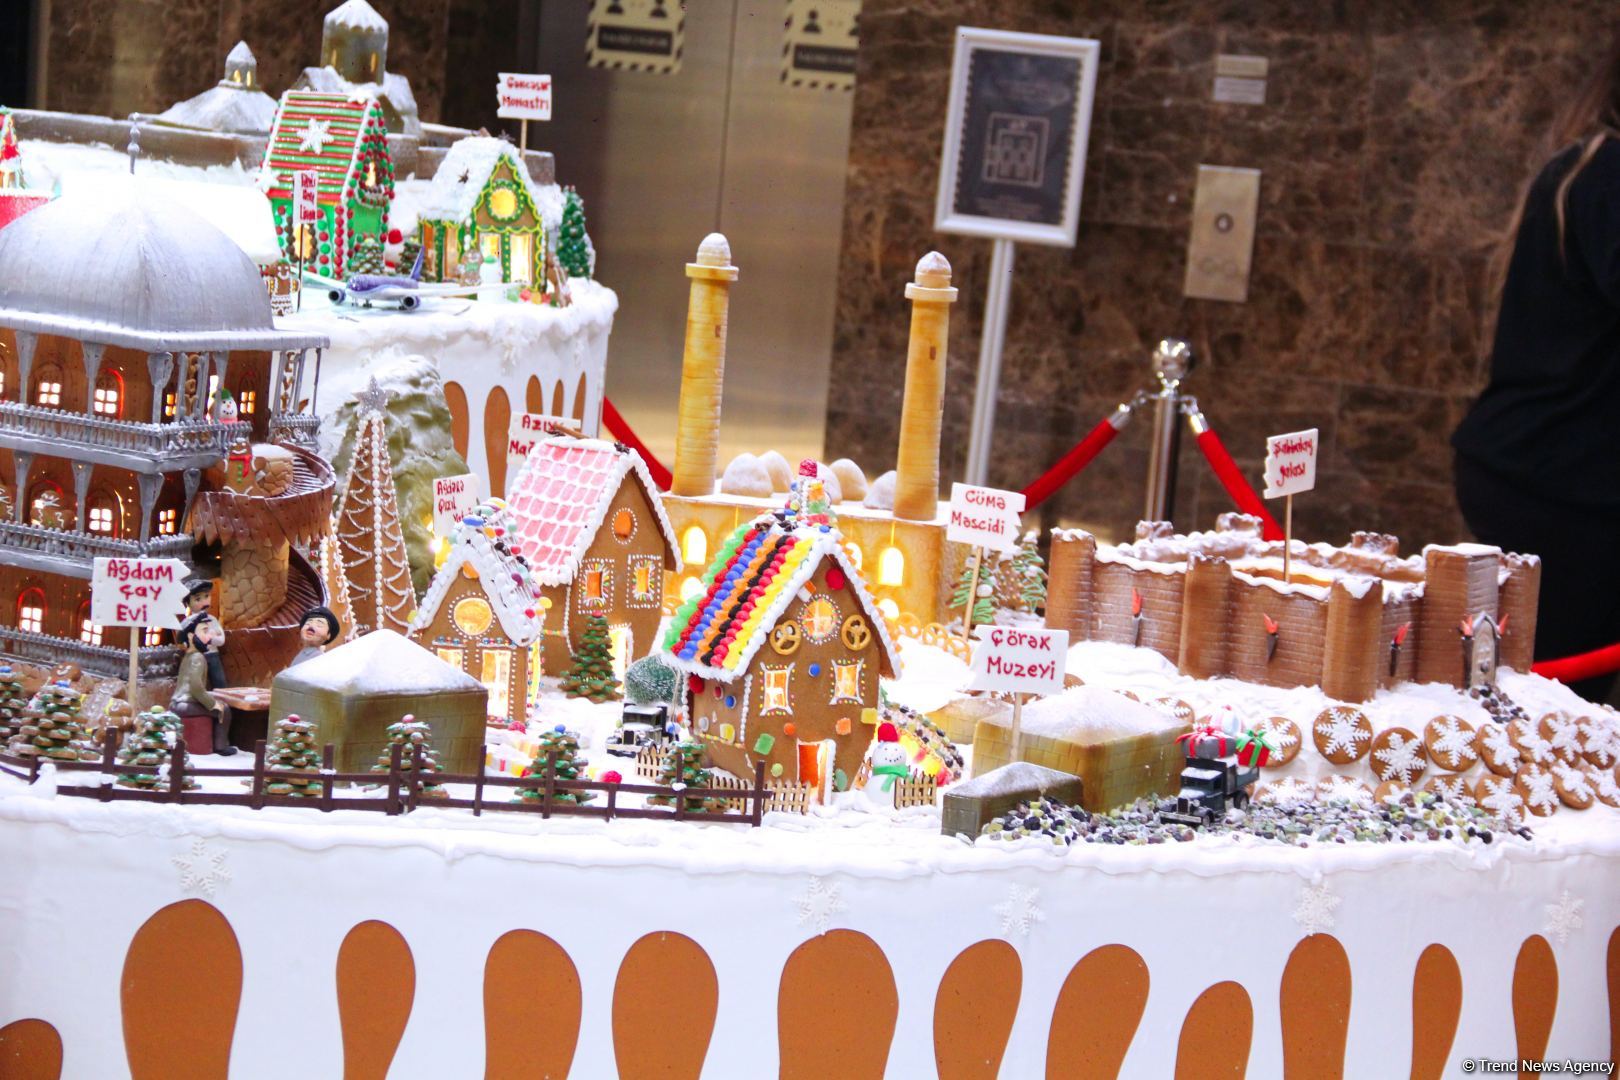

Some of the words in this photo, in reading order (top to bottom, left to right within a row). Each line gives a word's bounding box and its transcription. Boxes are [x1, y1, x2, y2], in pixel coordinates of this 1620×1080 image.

[951, 509, 1005, 536] Məscidi
[116, 604, 148, 622] Evi
[987, 655, 1056, 681] Muzeyi
